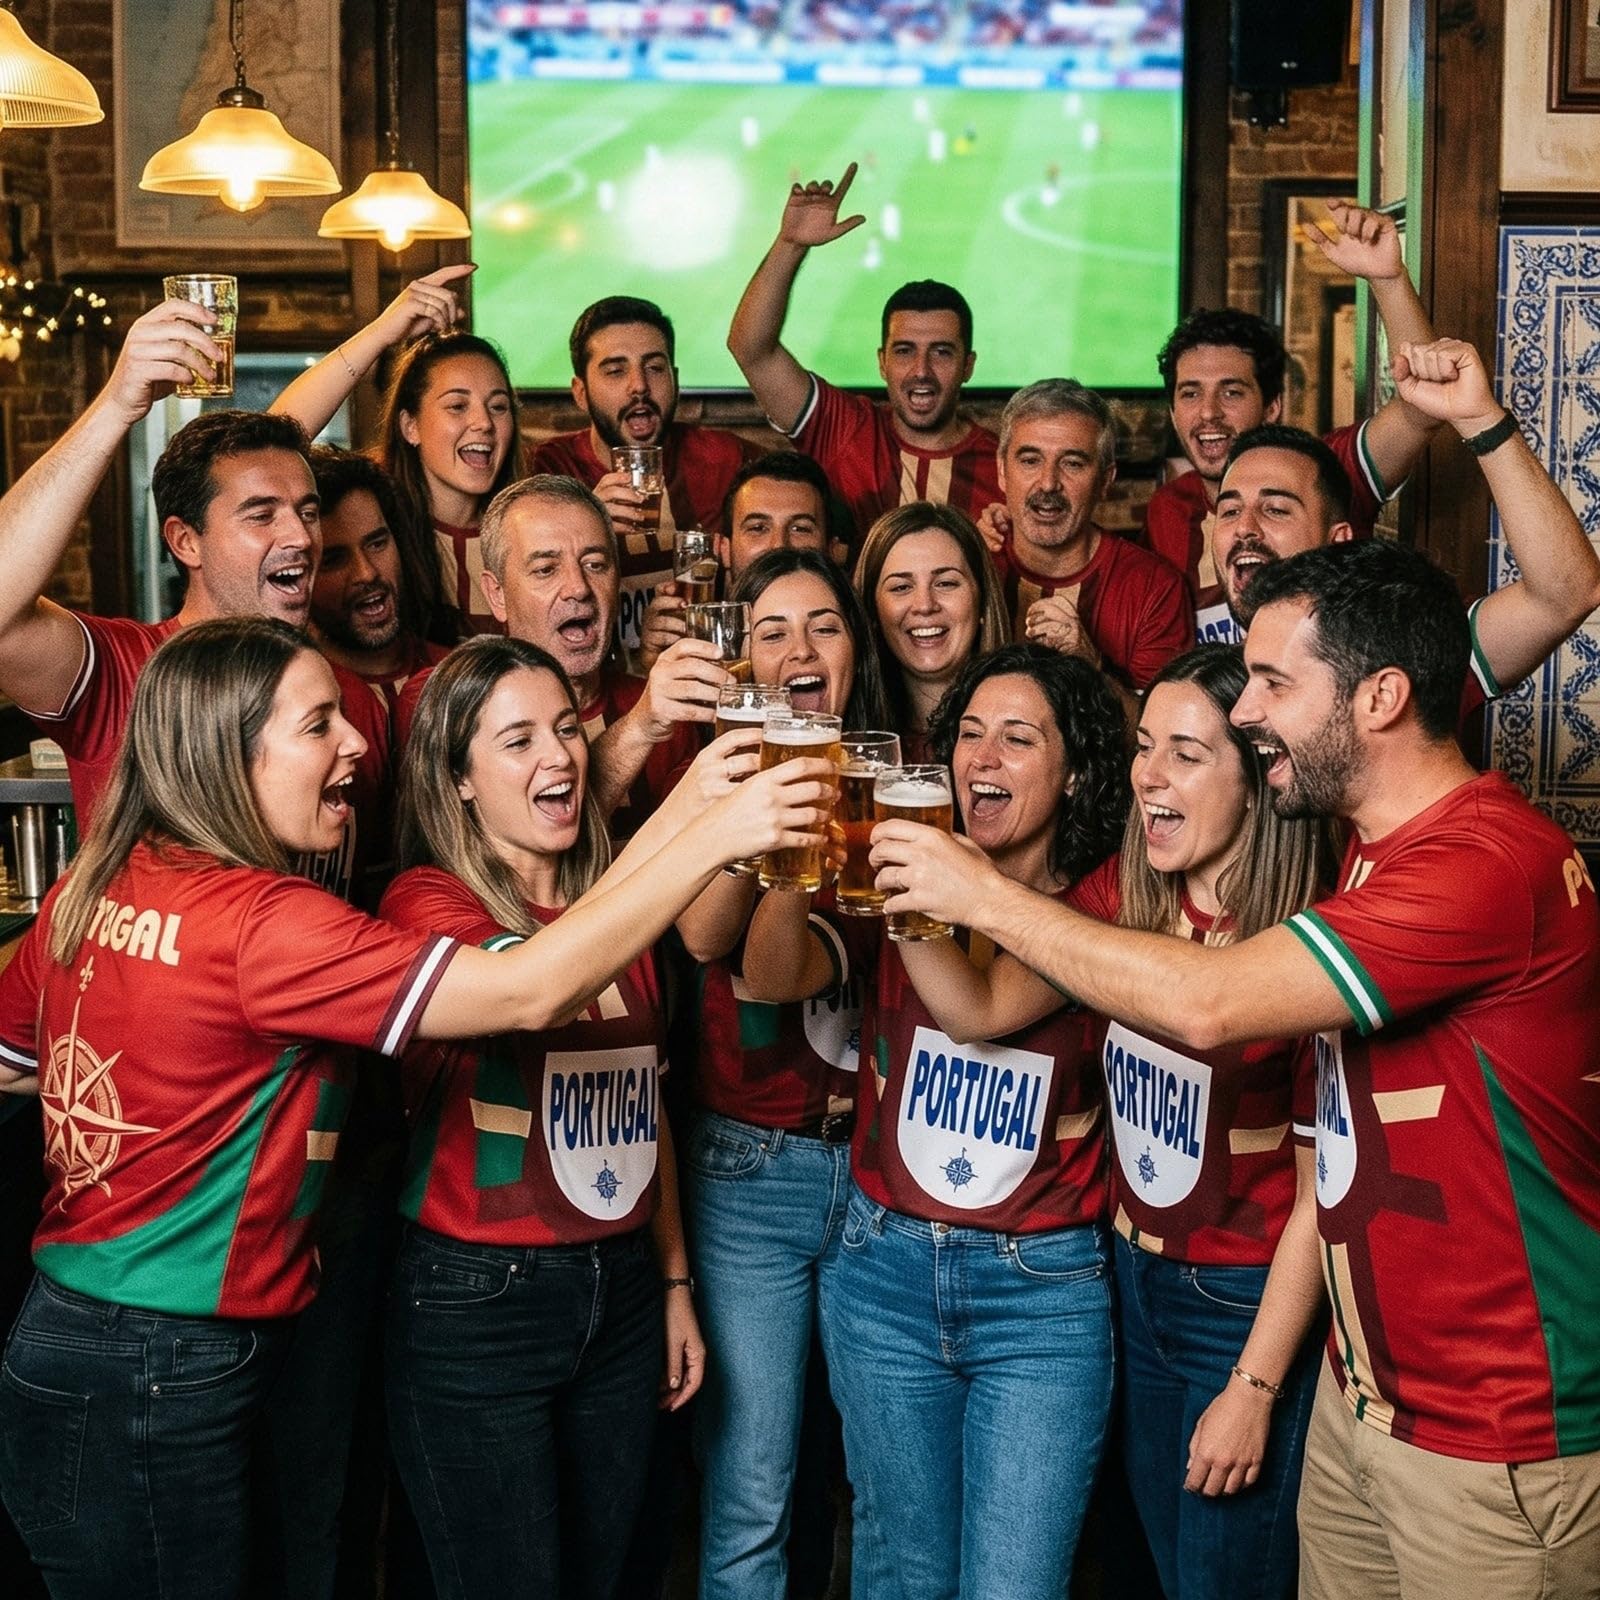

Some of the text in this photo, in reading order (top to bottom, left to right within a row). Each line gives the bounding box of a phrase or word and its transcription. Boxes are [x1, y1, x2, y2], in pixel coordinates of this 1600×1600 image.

[620, 587, 655, 640] PO
[550, 1066, 657, 1151] PORTUGAL
[907, 1049, 1042, 1152] PORTUGAL
[1105, 1039, 1200, 1160] PORTUGAL
